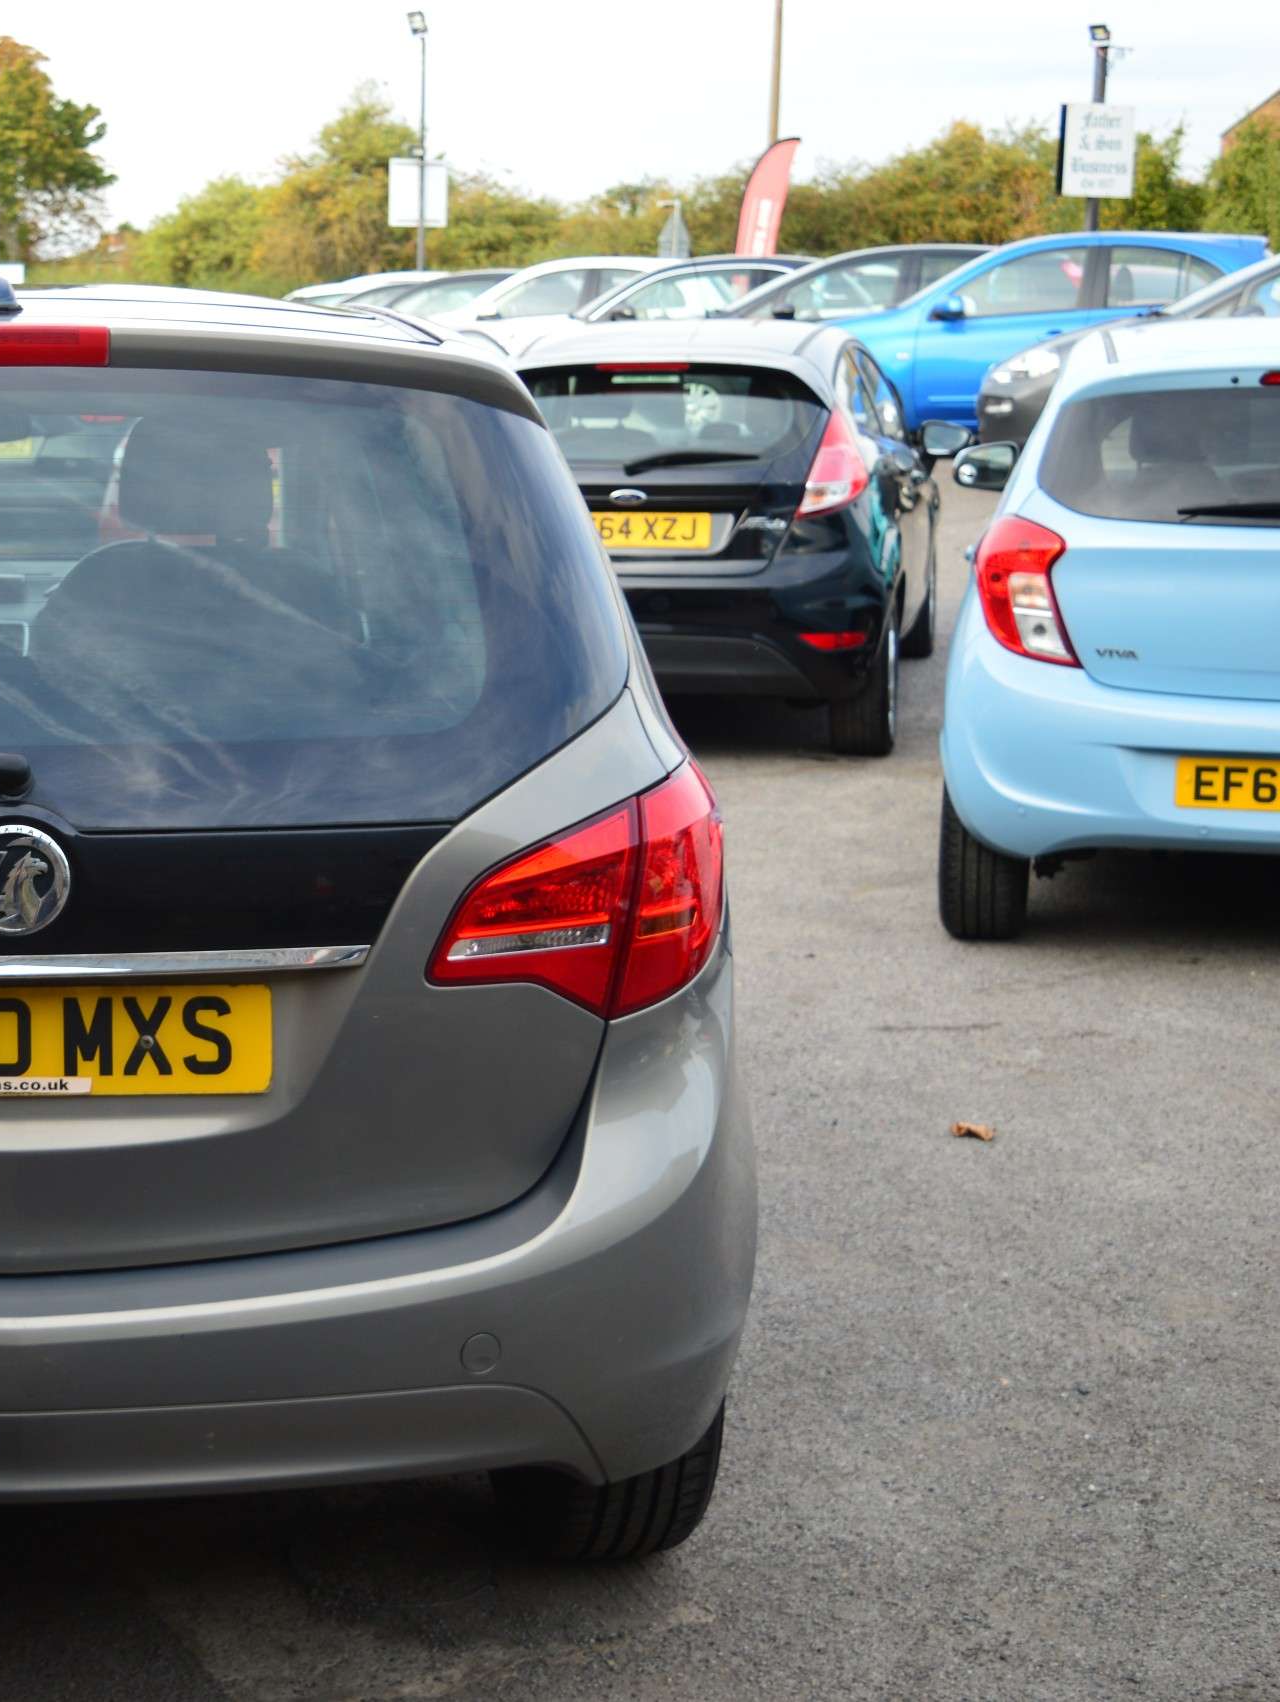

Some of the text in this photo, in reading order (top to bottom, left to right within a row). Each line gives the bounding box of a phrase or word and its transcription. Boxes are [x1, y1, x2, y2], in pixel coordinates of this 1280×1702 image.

[642, 517, 697, 541] XZJ
[1095, 648, 1138, 661] VIVA
[1193, 764, 1278, 803] EF6
[62, 995, 232, 1077] MXS
